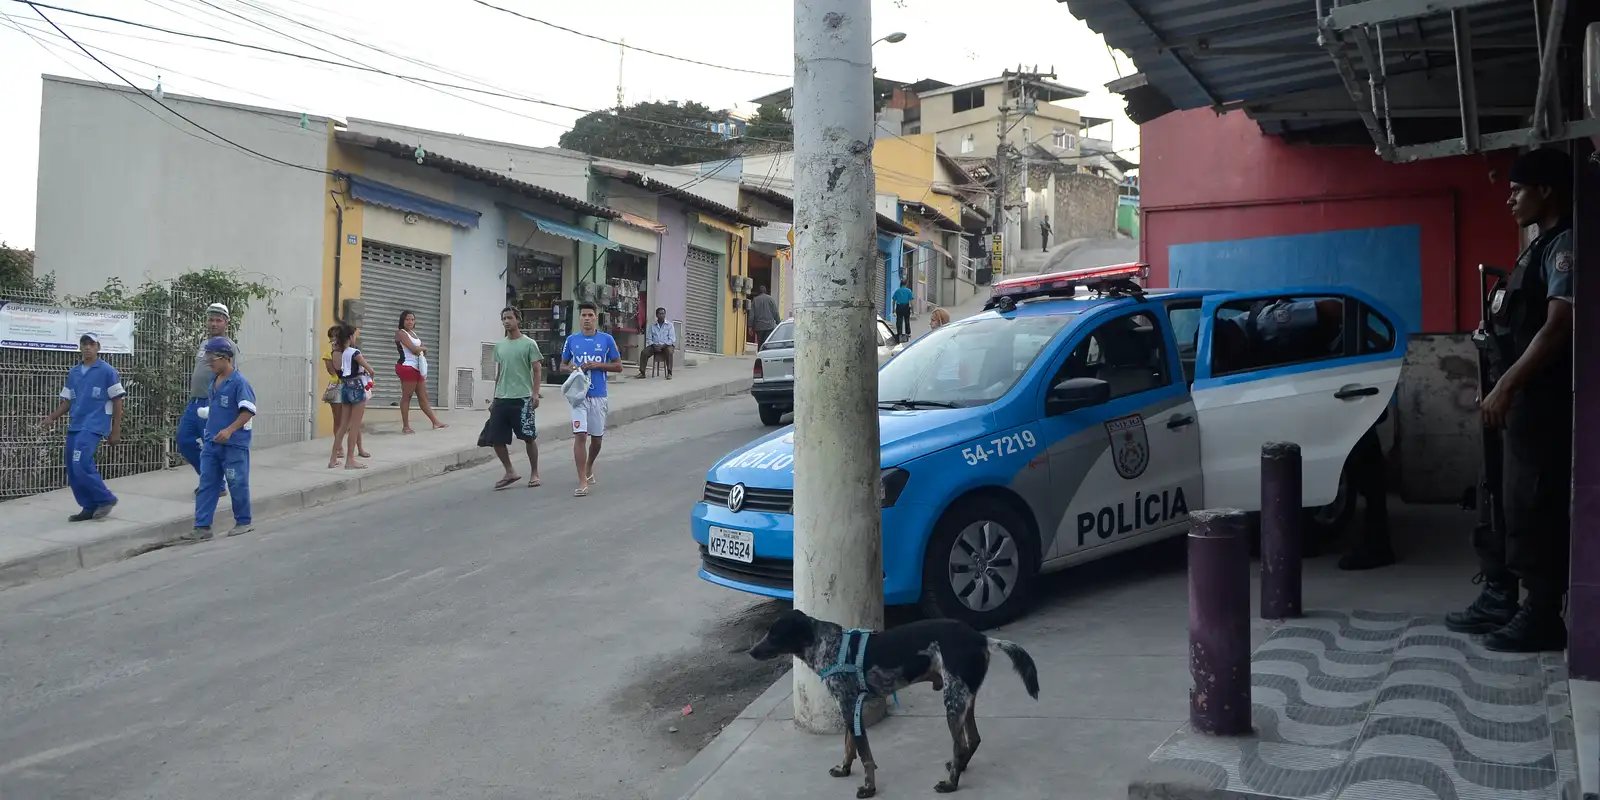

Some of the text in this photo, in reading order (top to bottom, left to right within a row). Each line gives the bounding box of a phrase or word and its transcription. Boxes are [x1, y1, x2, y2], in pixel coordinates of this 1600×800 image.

[6, 305, 43, 313] SUPLETIVO
[575, 351, 602, 363] vivo
[961, 429, 1037, 467] 54-7219
[1077, 486, 1189, 547] POLÍCIA
